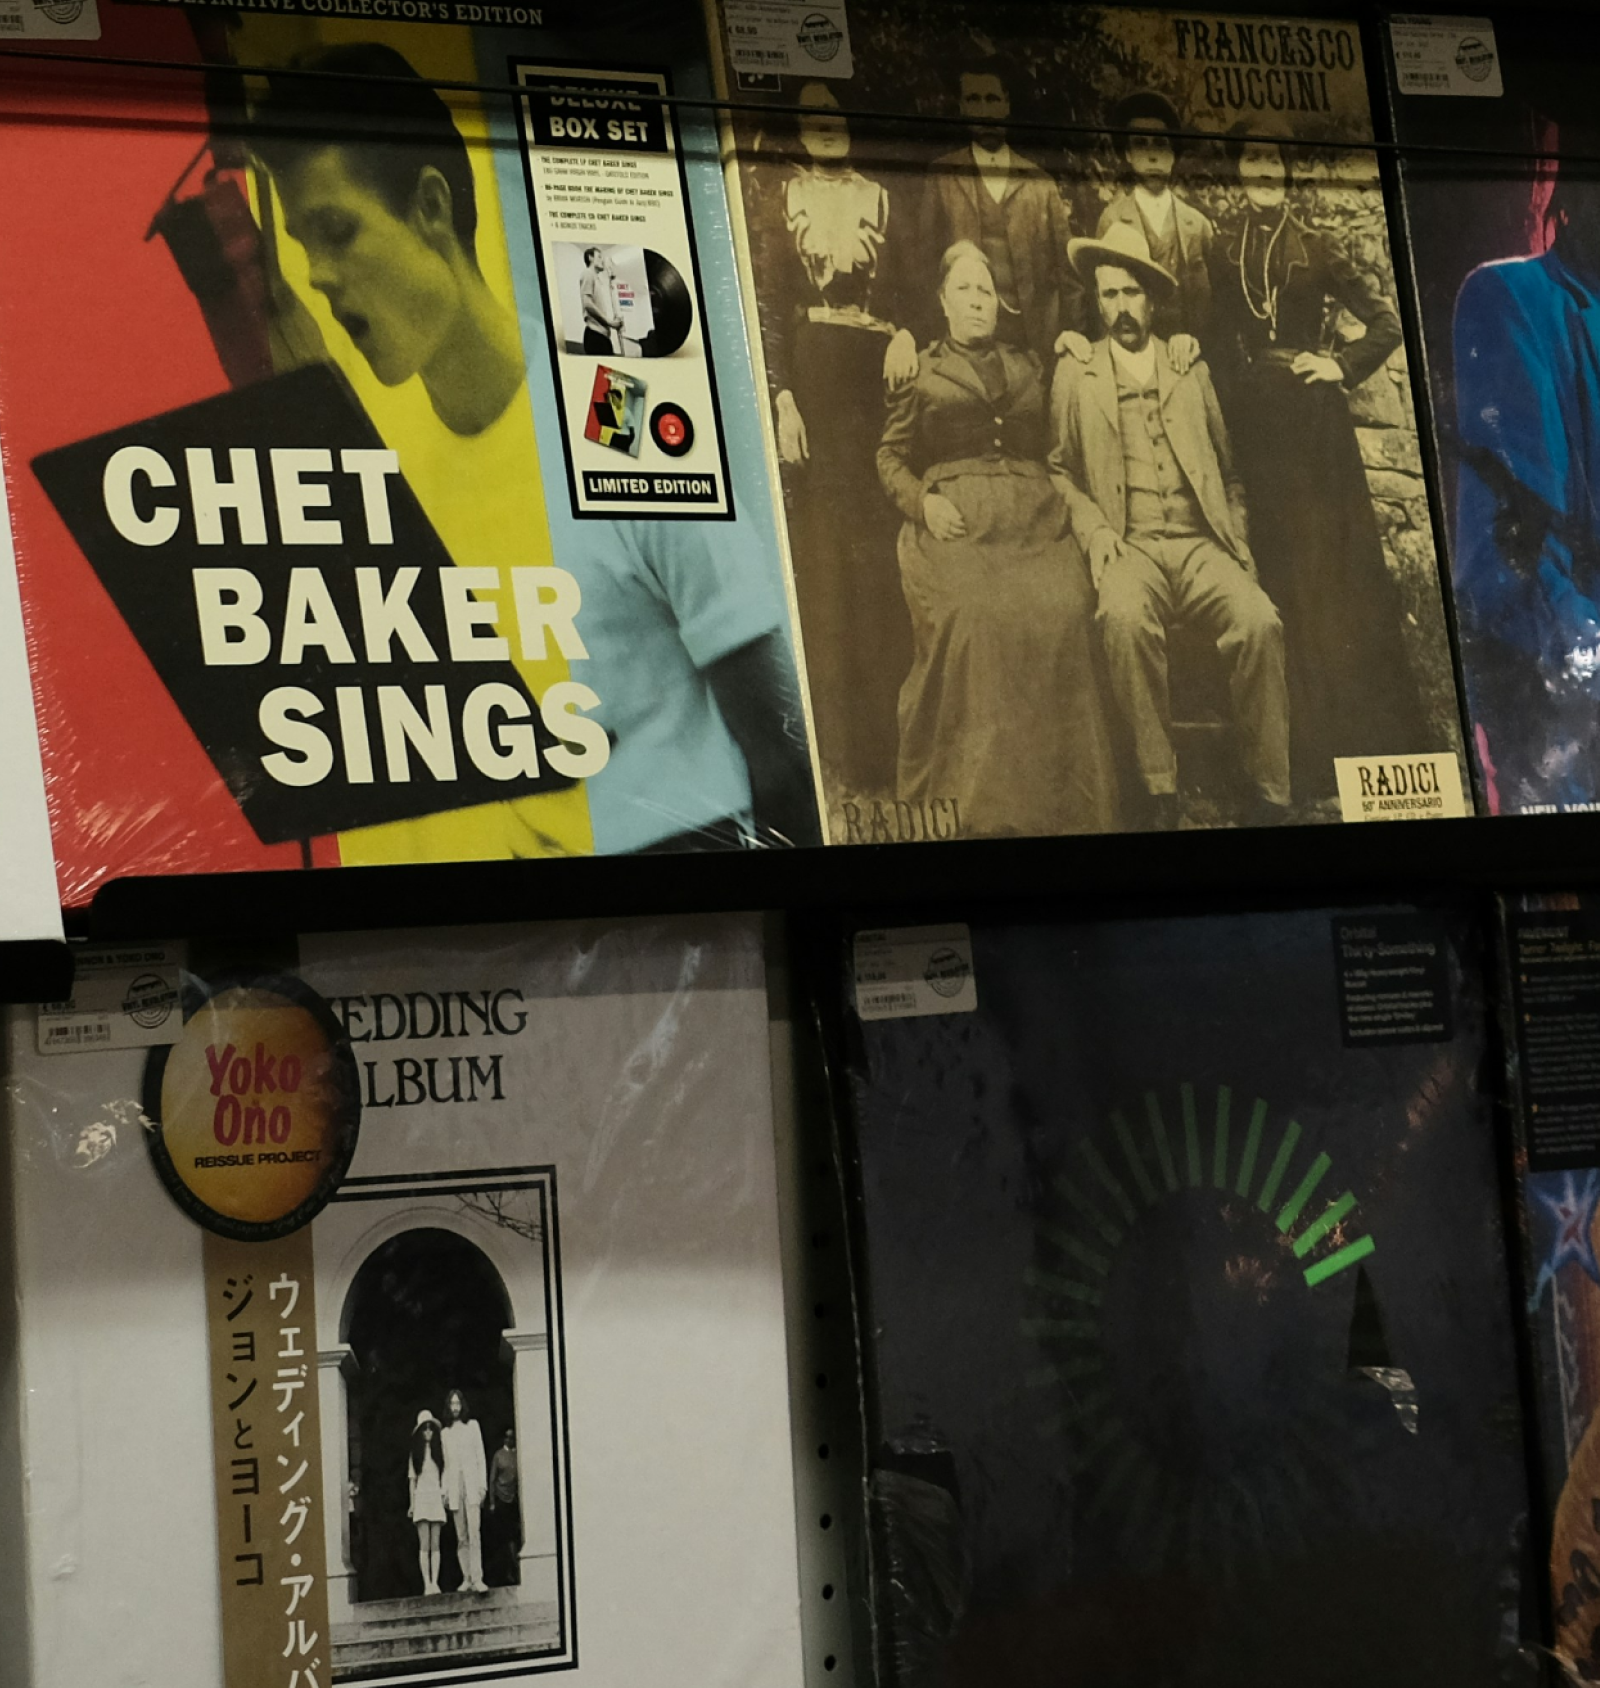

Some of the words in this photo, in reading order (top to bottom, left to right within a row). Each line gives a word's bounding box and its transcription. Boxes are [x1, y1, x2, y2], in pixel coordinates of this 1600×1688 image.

[455, 1, 543, 27] EDITION
[1174, 18, 1355, 71] FRANCESCO
[1203, 65, 1332, 112] GUCCINI
[548, 115, 601, 141] BOX
[606, 118, 649, 144] SET
[101, 444, 401, 547] CHET
[589, 477, 649, 494] LIMITED
[653, 479, 712, 495] EDITION
[190, 564, 591, 666] BAKER
[258, 680, 612, 788] SINGS
[1357, 761, 1442, 797] RADICI
[841, 798, 962, 845] RADICI
[203, 1042, 301, 1097] Yoko
[360, 1053, 505, 1109] LBUM
[212, 1095, 293, 1147] Ono
[194, 1154, 255, 1170] REISSUE
[257, 1149, 322, 1167] PROJECT
[221, 1272, 264, 1587] ジョンとヨーコ
